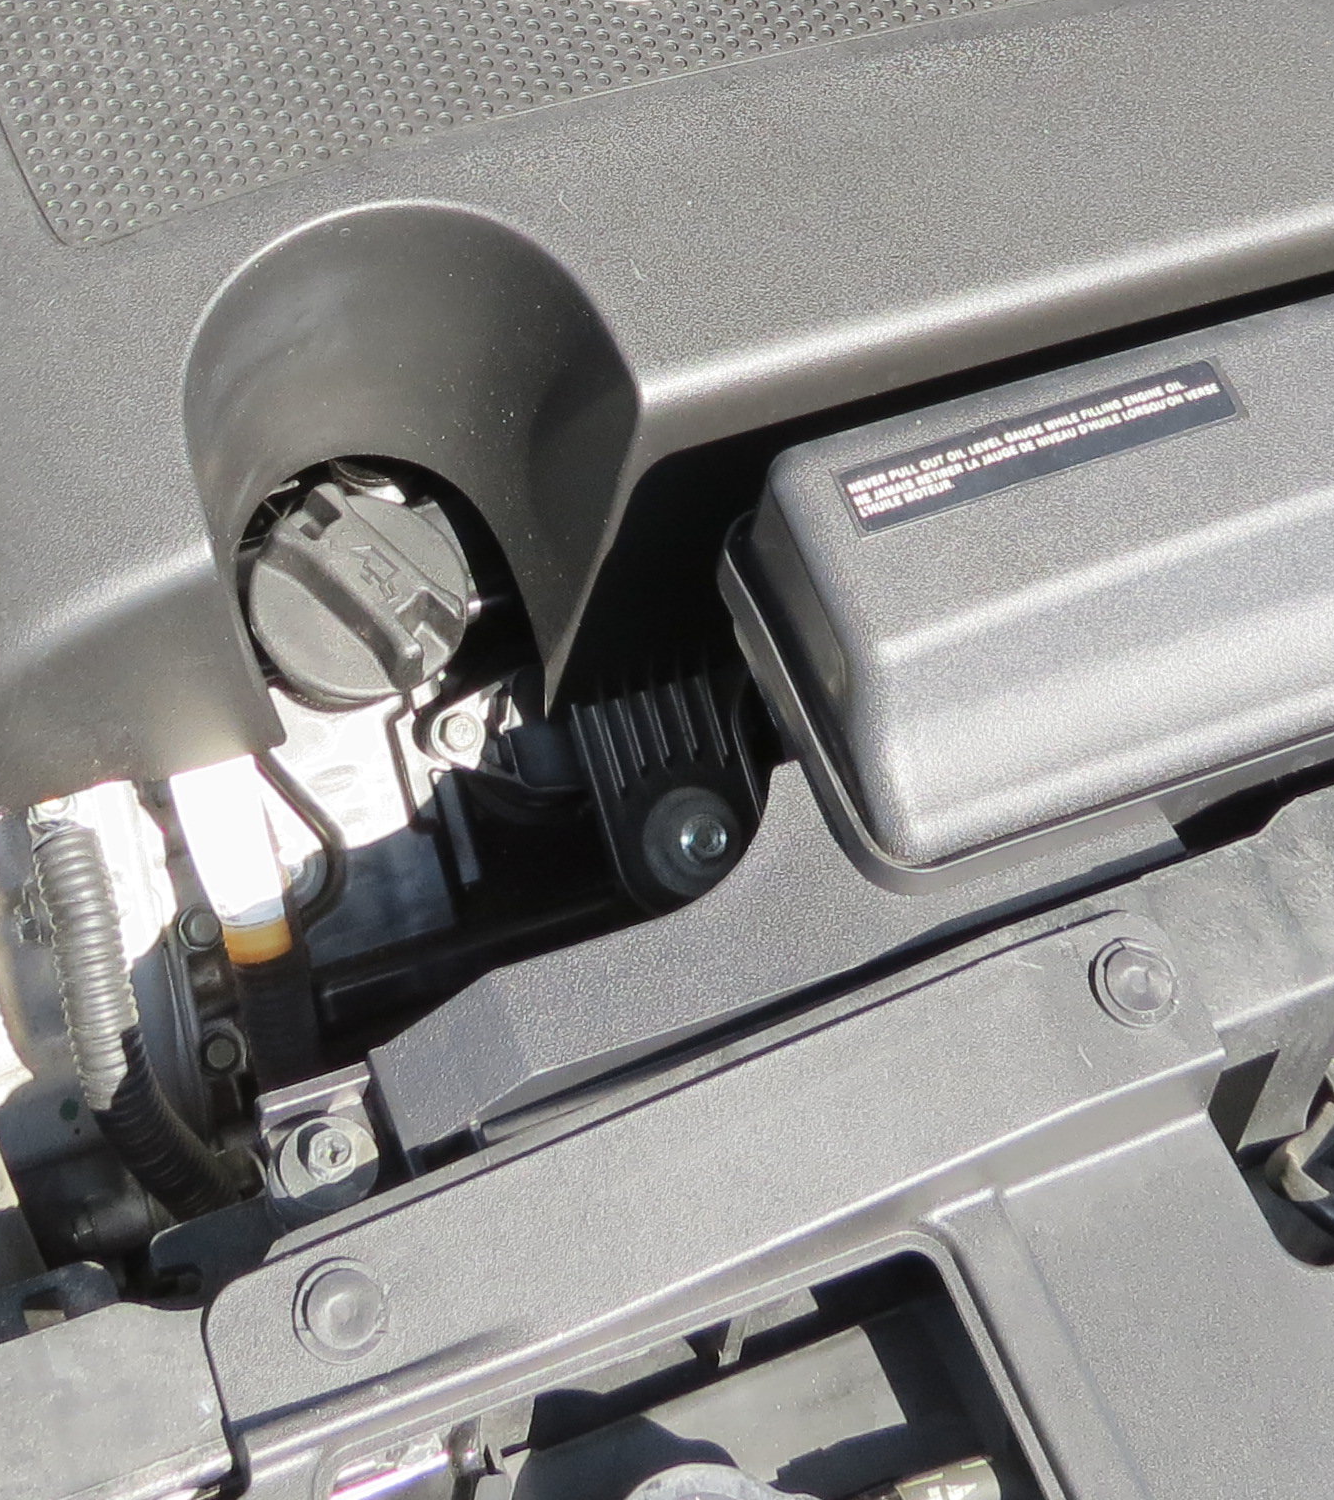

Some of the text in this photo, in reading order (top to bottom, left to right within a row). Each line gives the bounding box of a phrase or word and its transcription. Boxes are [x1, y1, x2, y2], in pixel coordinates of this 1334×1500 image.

[847, 378, 1186, 492] NEVER PULL OUT OIL LEVEL GAUGE WHILE FILLING ENGINE OIL.
[853, 492, 871, 504] NE
[873, 478, 914, 498] JAMAIS
[916, 463, 962, 484] RETIRER
[964, 457, 979, 469] LA
[981, 445, 1018, 464] JAUGE
[1019, 440, 1034, 452] DE
[1036, 427, 1075, 447] NIVEAU
[1078, 413, 1120, 433] D'HUILE
[1185, 382, 1218, 400] VERSE
[859, 479, 954, 516] L'HUILE MOTEUR.
